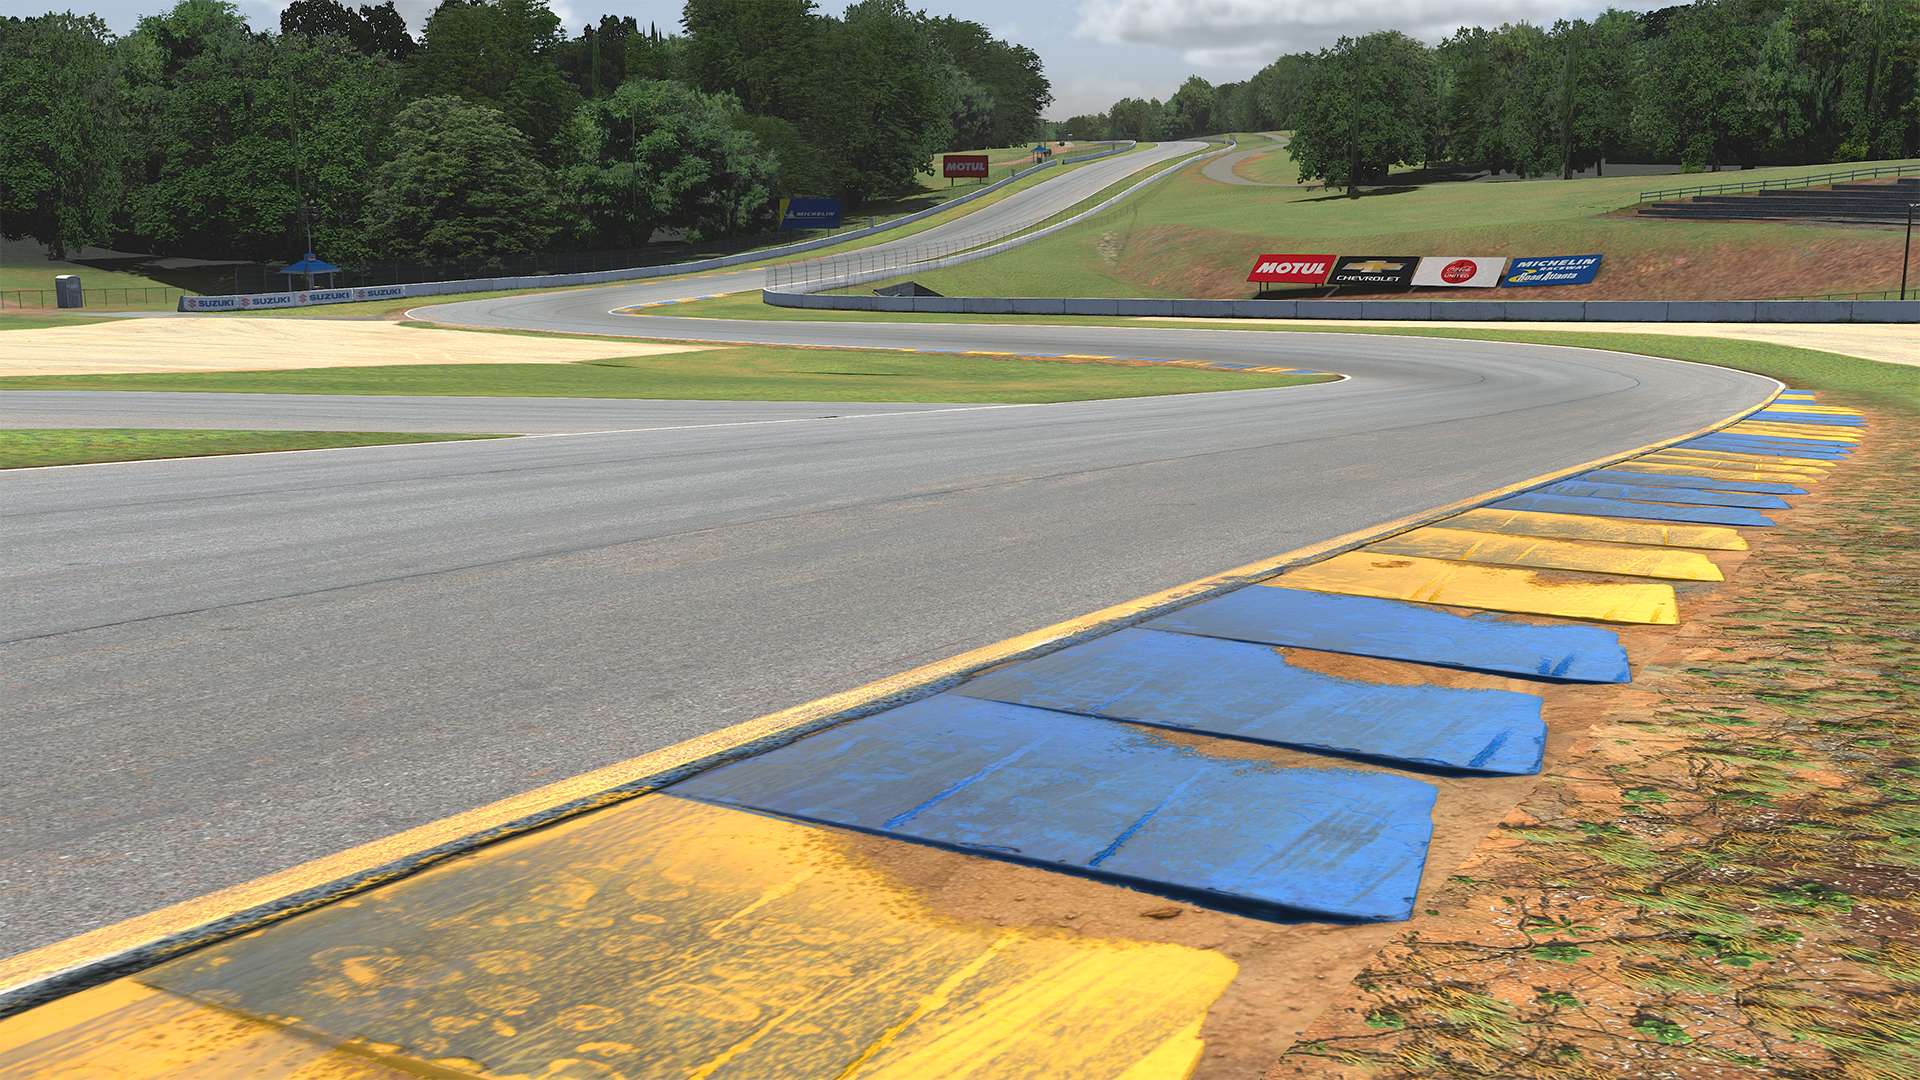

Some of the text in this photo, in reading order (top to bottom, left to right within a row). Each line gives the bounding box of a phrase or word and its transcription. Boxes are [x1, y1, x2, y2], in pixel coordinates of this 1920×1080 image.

[946, 162, 985, 171] MOTUL
[1517, 258, 1598, 268] MICHELIN
[1255, 262, 1326, 275] MOTUL
[1517, 271, 1578, 282] Road Atlanta
[309, 292, 350, 301] SUZUKI
[367, 288, 401, 297] SUZUKI
[198, 299, 234, 307] SUZUKI
[252, 296, 290, 305] SUZUKI
